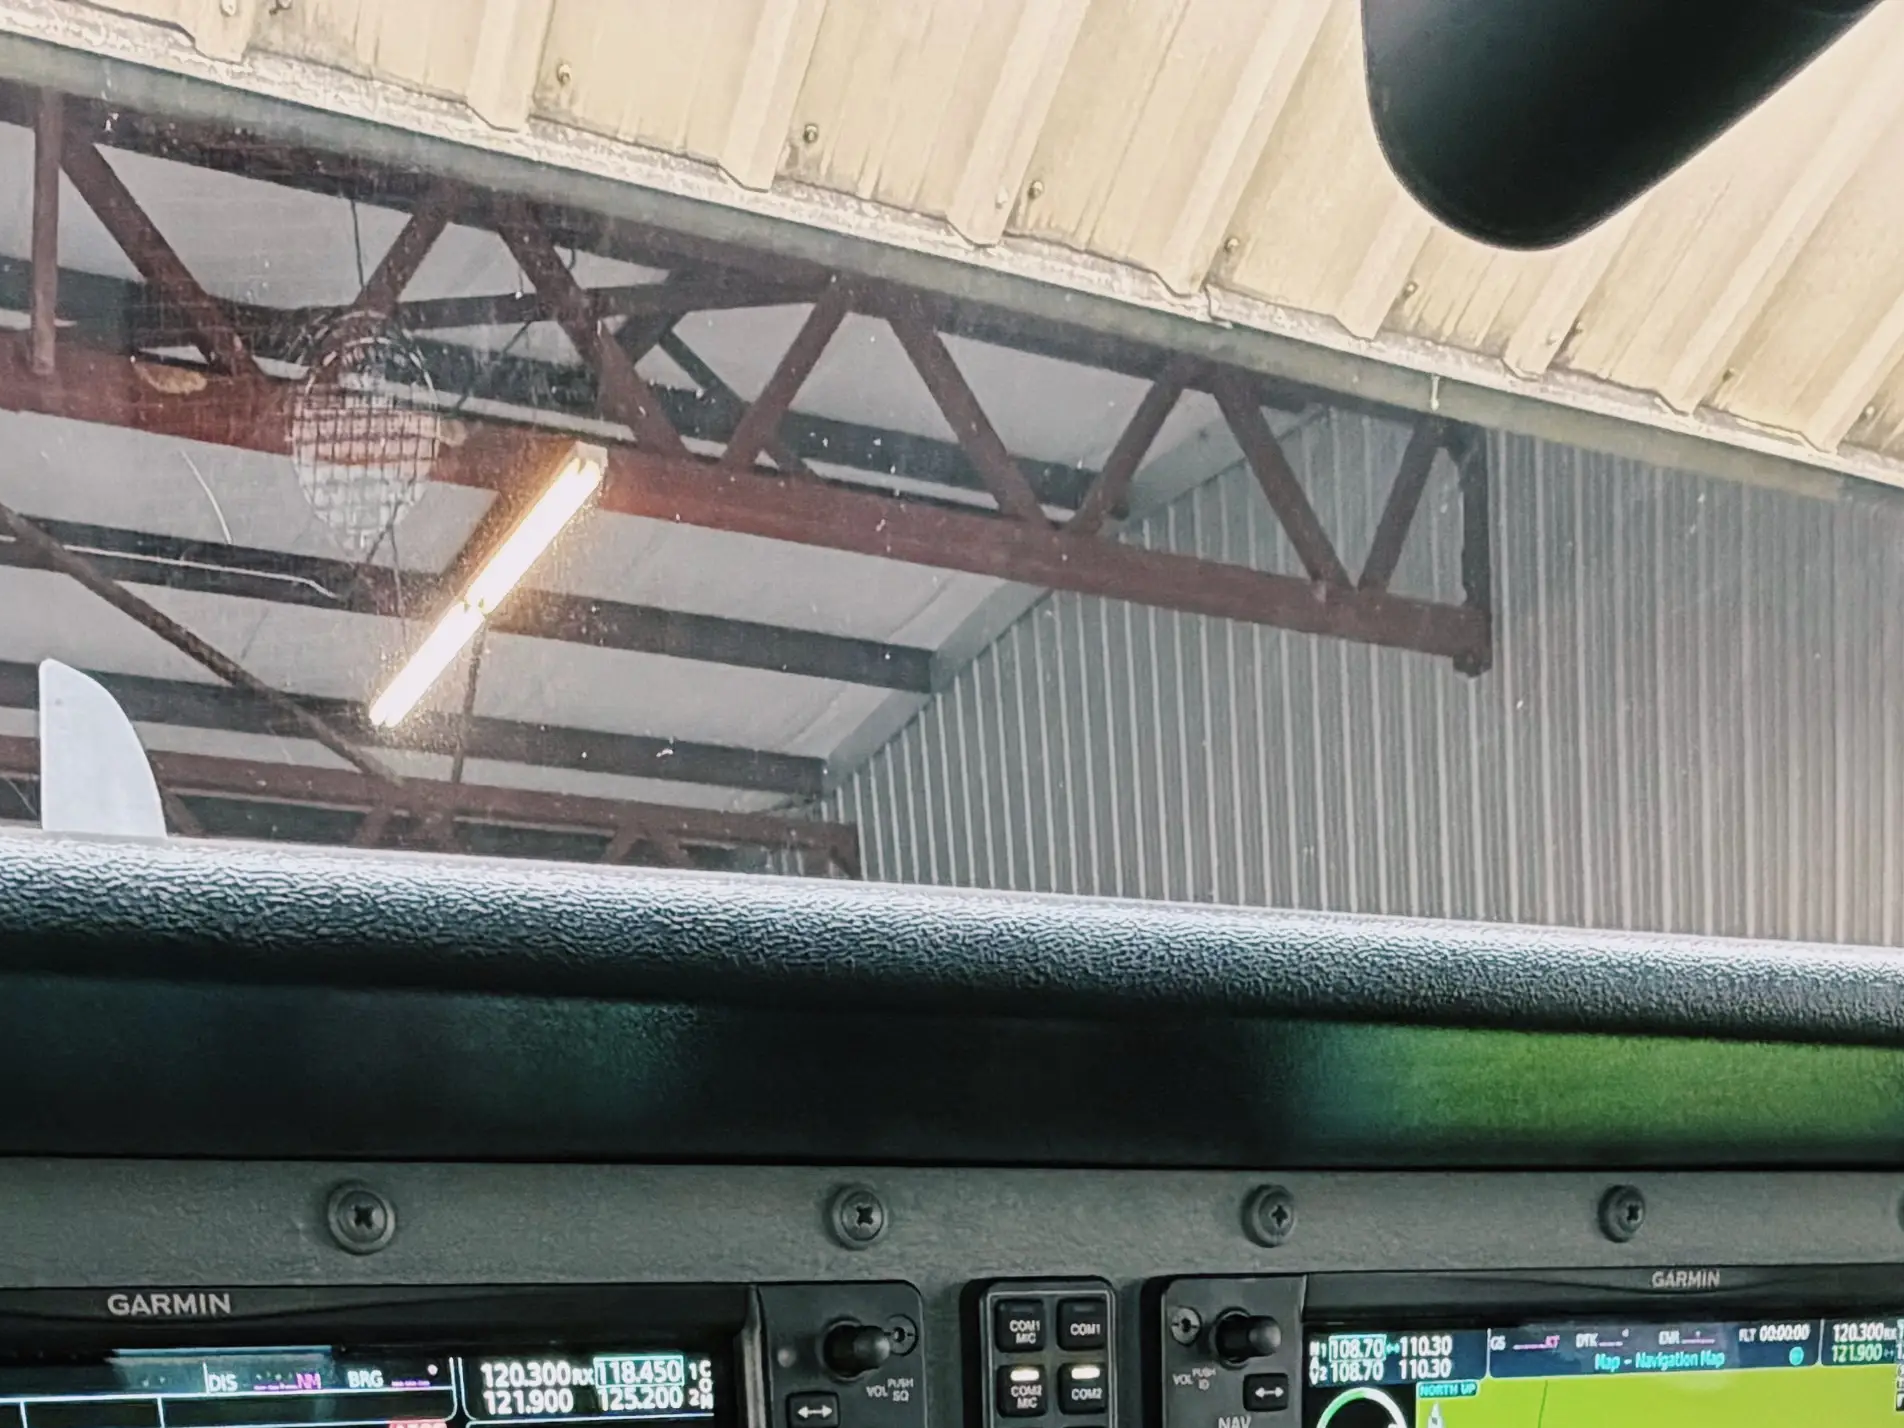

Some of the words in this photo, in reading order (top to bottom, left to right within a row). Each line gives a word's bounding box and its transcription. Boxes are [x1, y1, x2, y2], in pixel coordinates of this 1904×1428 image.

[1651, 1270, 1721, 1288] GARMIN
[107, 1293, 231, 1316] GARMIN
[1070, 1323, 1101, 1336] COM1
[481, 1362, 571, 1388] 120.300
[598, 1359, 681, 1385] 118.450
